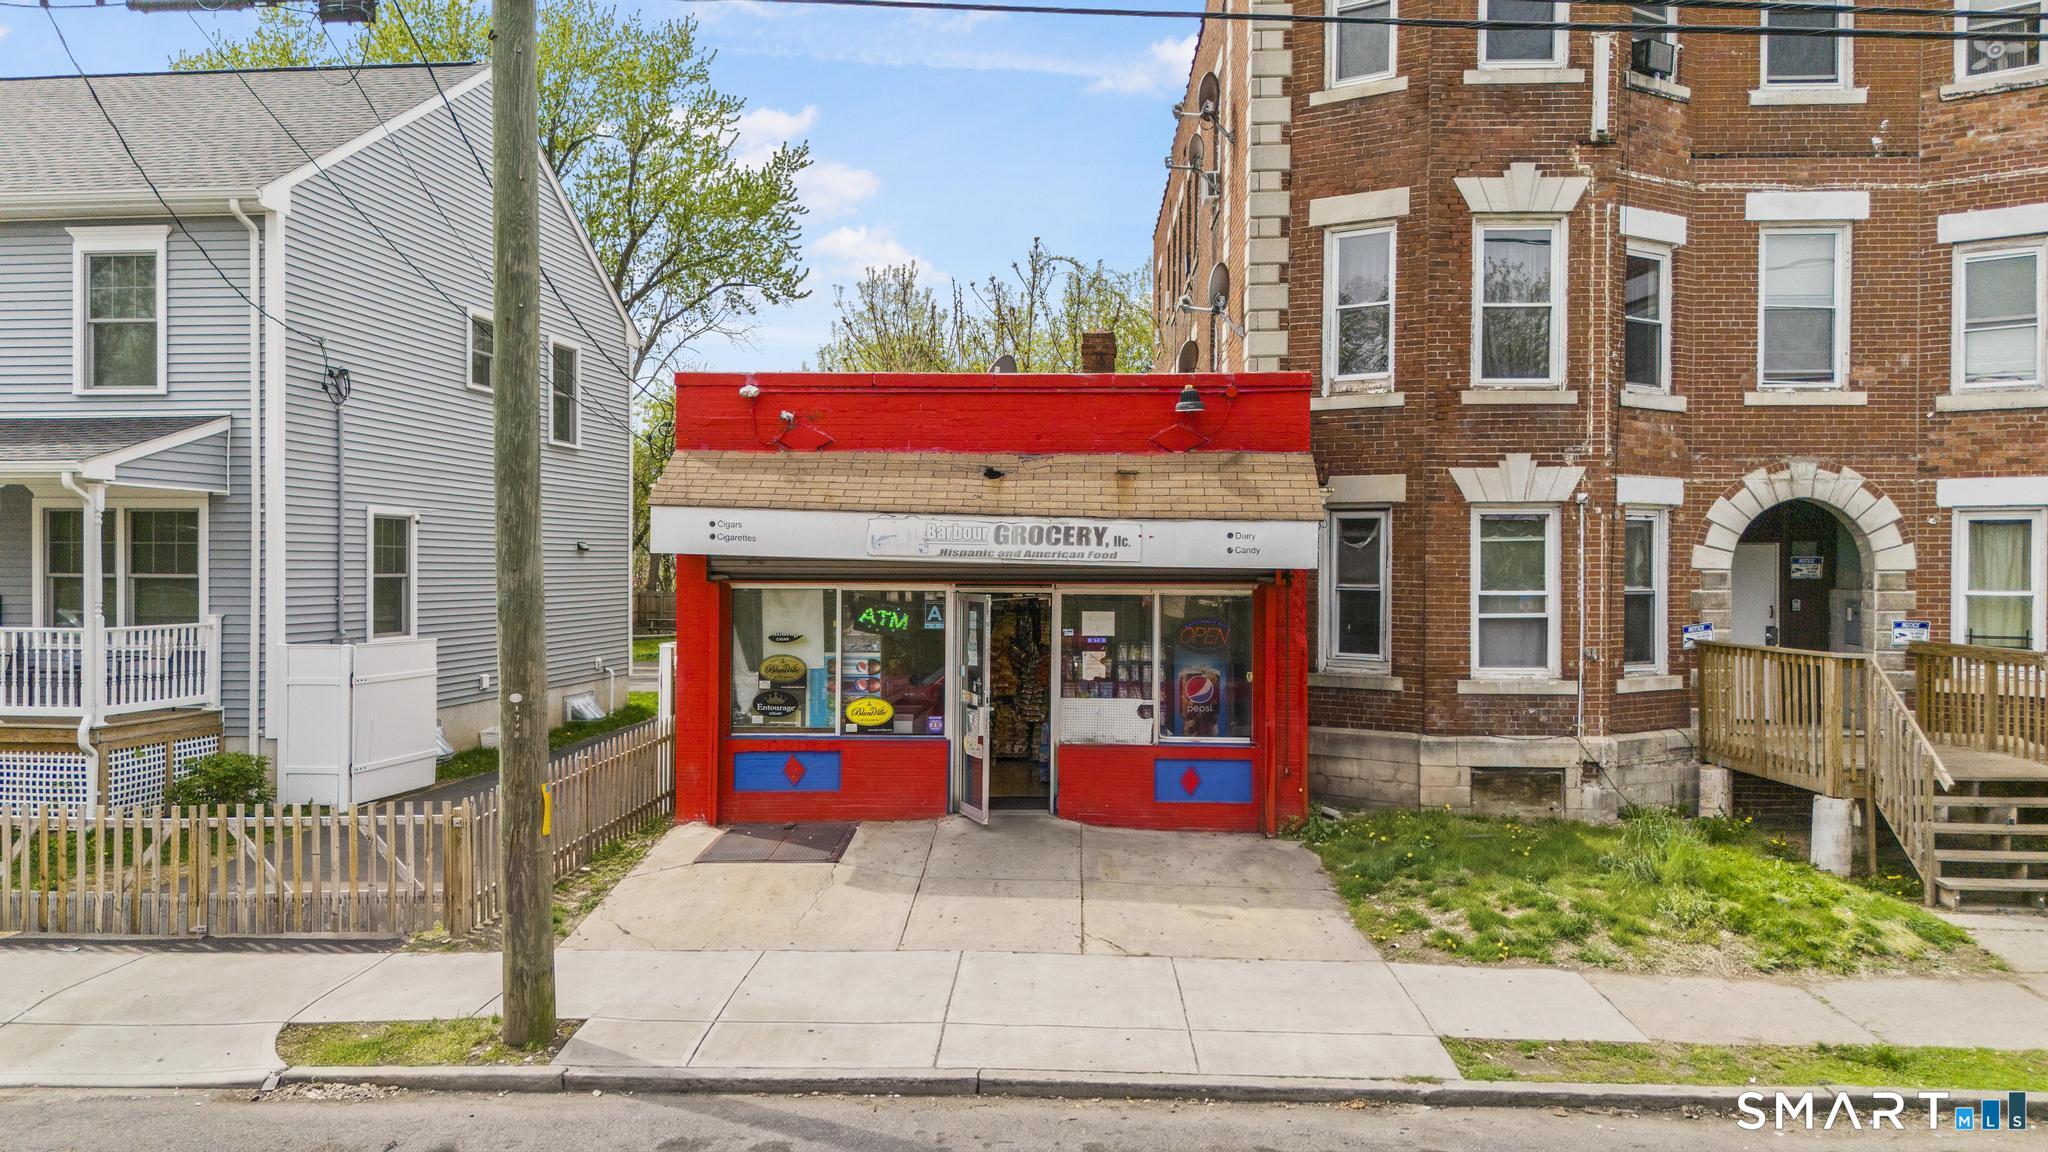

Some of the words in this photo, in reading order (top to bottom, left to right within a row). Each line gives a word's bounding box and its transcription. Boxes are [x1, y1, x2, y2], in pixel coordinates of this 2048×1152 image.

[717, 520, 743, 530] Cigars
[717, 533, 757, 543] Cigarettes
[926, 523, 989, 541] Barbour
[994, 525, 1109, 548] GROCERY,
[1235, 532, 1256, 541] Dairy
[939, 548, 995, 558] Hispanic
[999, 549, 1021, 558] and
[1023, 550, 1084, 559] American
[1087, 551, 1118, 560] Food
[1235, 546, 1260, 556] Candy
[927, 605, 943, 621] A
[859, 607, 909, 630] ATM
[1181, 626, 1230, 645] OPEN
[757, 703, 796, 712] Entourage
[1187, 704, 1213, 713] pepsi
